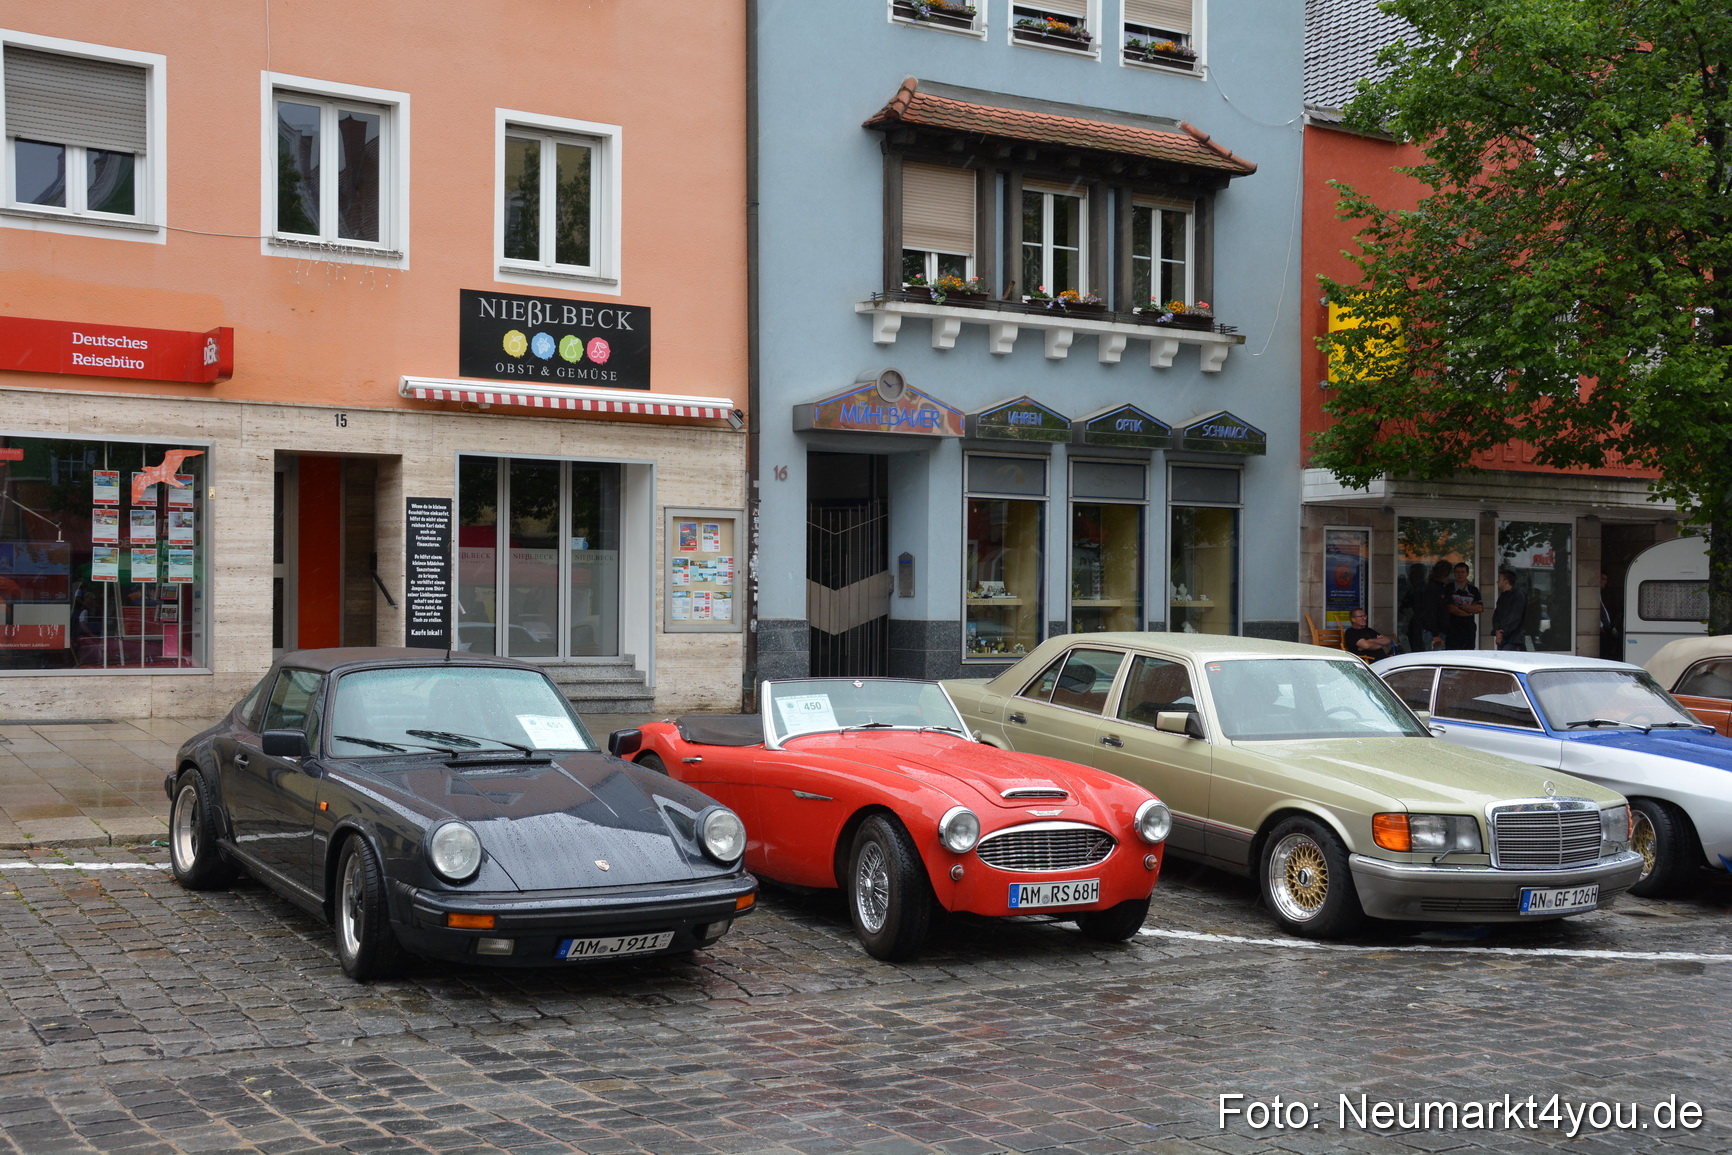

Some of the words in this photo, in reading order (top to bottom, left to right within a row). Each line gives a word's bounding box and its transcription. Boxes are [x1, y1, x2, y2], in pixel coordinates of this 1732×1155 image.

[478, 297, 634, 331] NIEßLBECK
[72, 332, 148, 350] Deutsches
[72, 353, 145, 370] Reisebüro
[495, 362, 535, 375] OBST
[540, 366, 550, 377] &
[556, 367, 618, 381] GEMÜSE
[334, 413, 347, 428] 15
[839, 401, 941, 429] MÜHLBAUER
[1007, 410, 1043, 426] UHREN
[1115, 418, 1143, 433] OPTIK
[1202, 424, 1249, 440] SCHMUCK
[773, 465, 788, 481] 16
[804, 702, 822, 710] 450
[1020, 886, 1040, 904] AM
[1530, 892, 1547, 908] AN
[571, 940, 601, 956] AM
